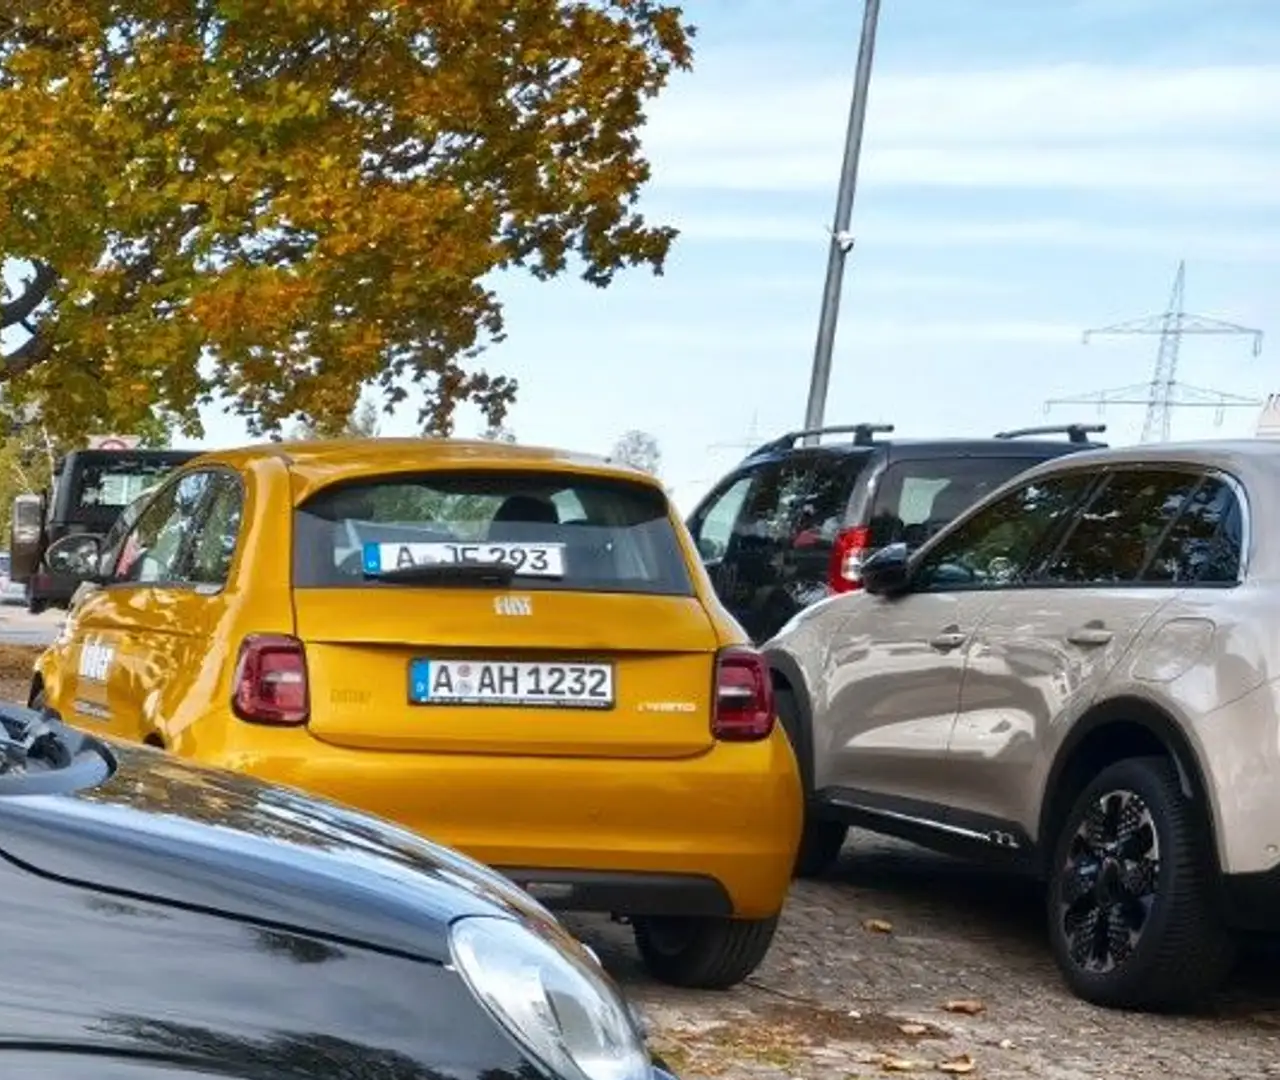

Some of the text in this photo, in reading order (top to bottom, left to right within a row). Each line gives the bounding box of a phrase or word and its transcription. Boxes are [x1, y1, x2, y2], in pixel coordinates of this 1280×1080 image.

[396, 545, 417, 568] A
[433, 664, 608, 697] A AH 1232
